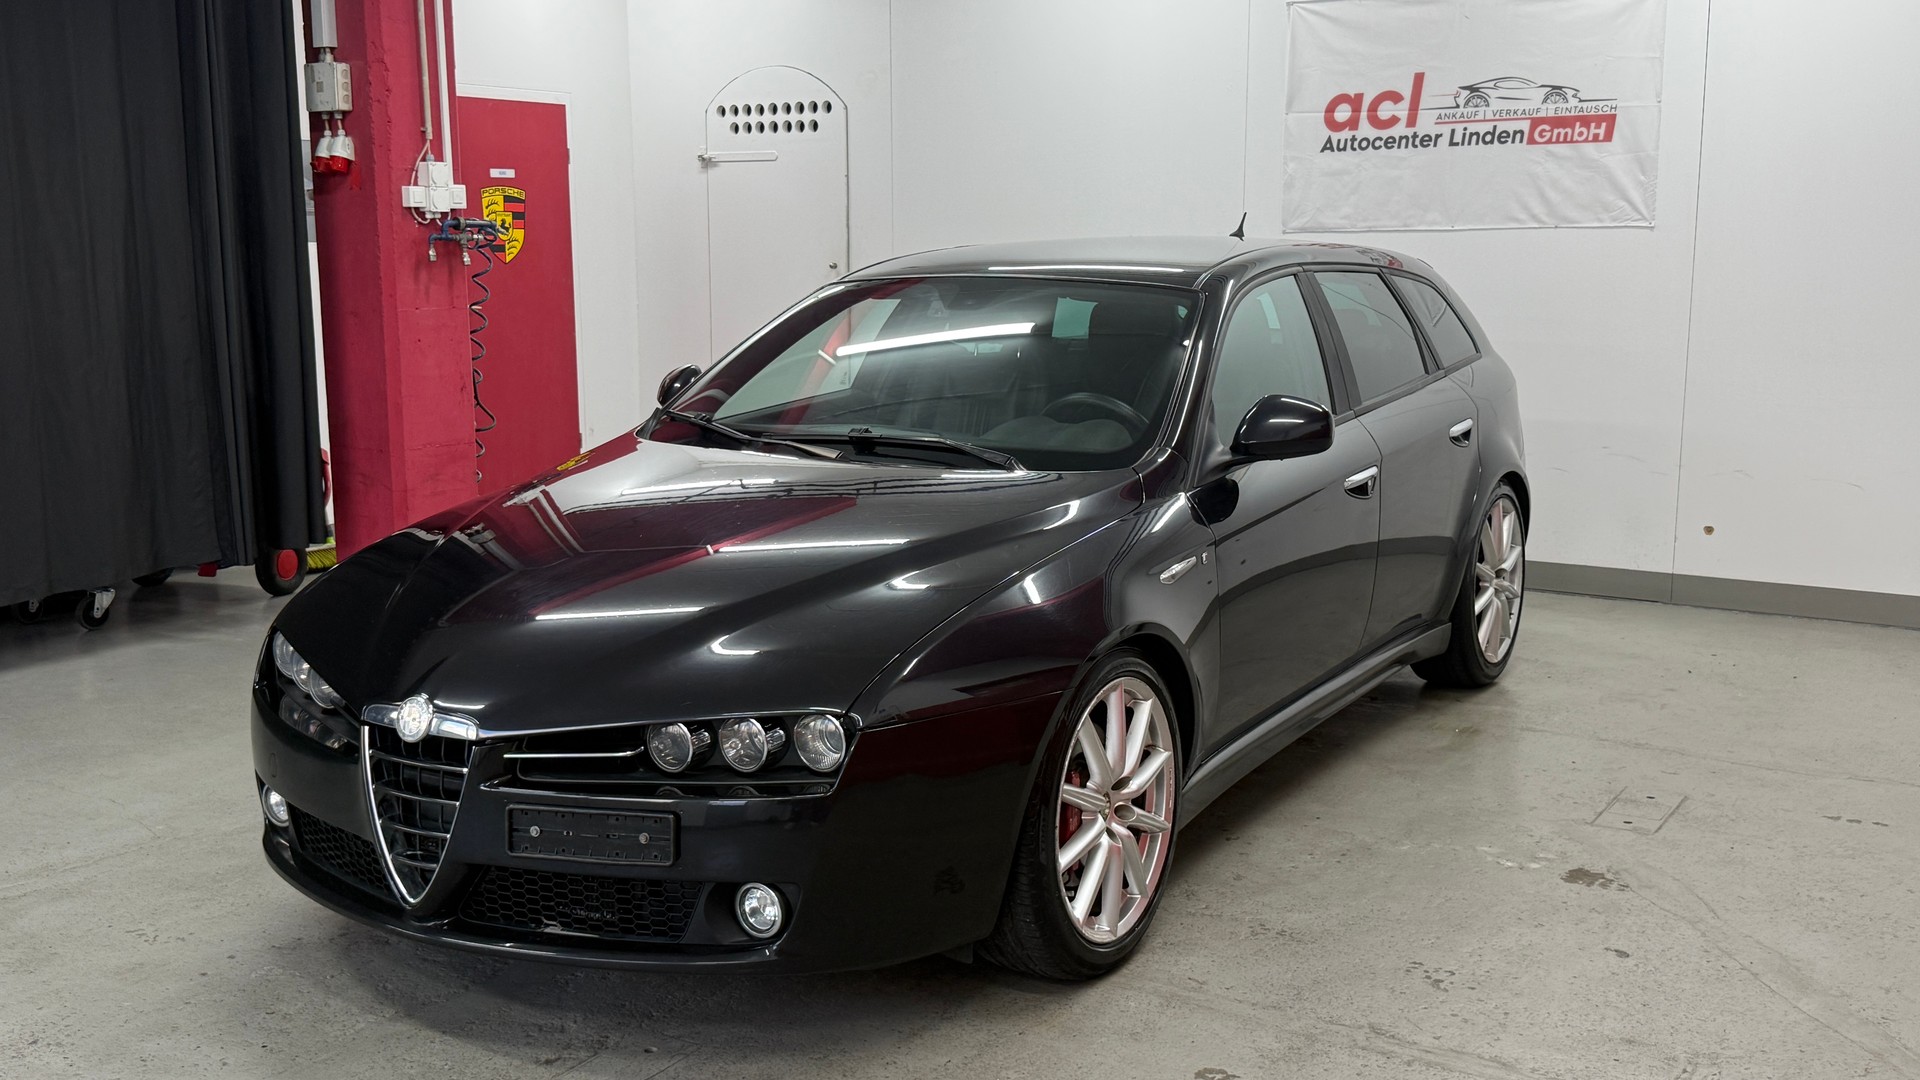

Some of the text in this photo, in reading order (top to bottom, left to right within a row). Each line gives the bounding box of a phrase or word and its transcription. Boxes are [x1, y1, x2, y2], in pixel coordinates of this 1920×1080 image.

[1323, 71, 1425, 133] acl
[1435, 104, 1618, 121] ANKAUF VERKAUF EINTAUSCH
[1319, 121, 1606, 153] Autocenter Linden GmbH
[482, 187, 525, 198] PORSCHE
